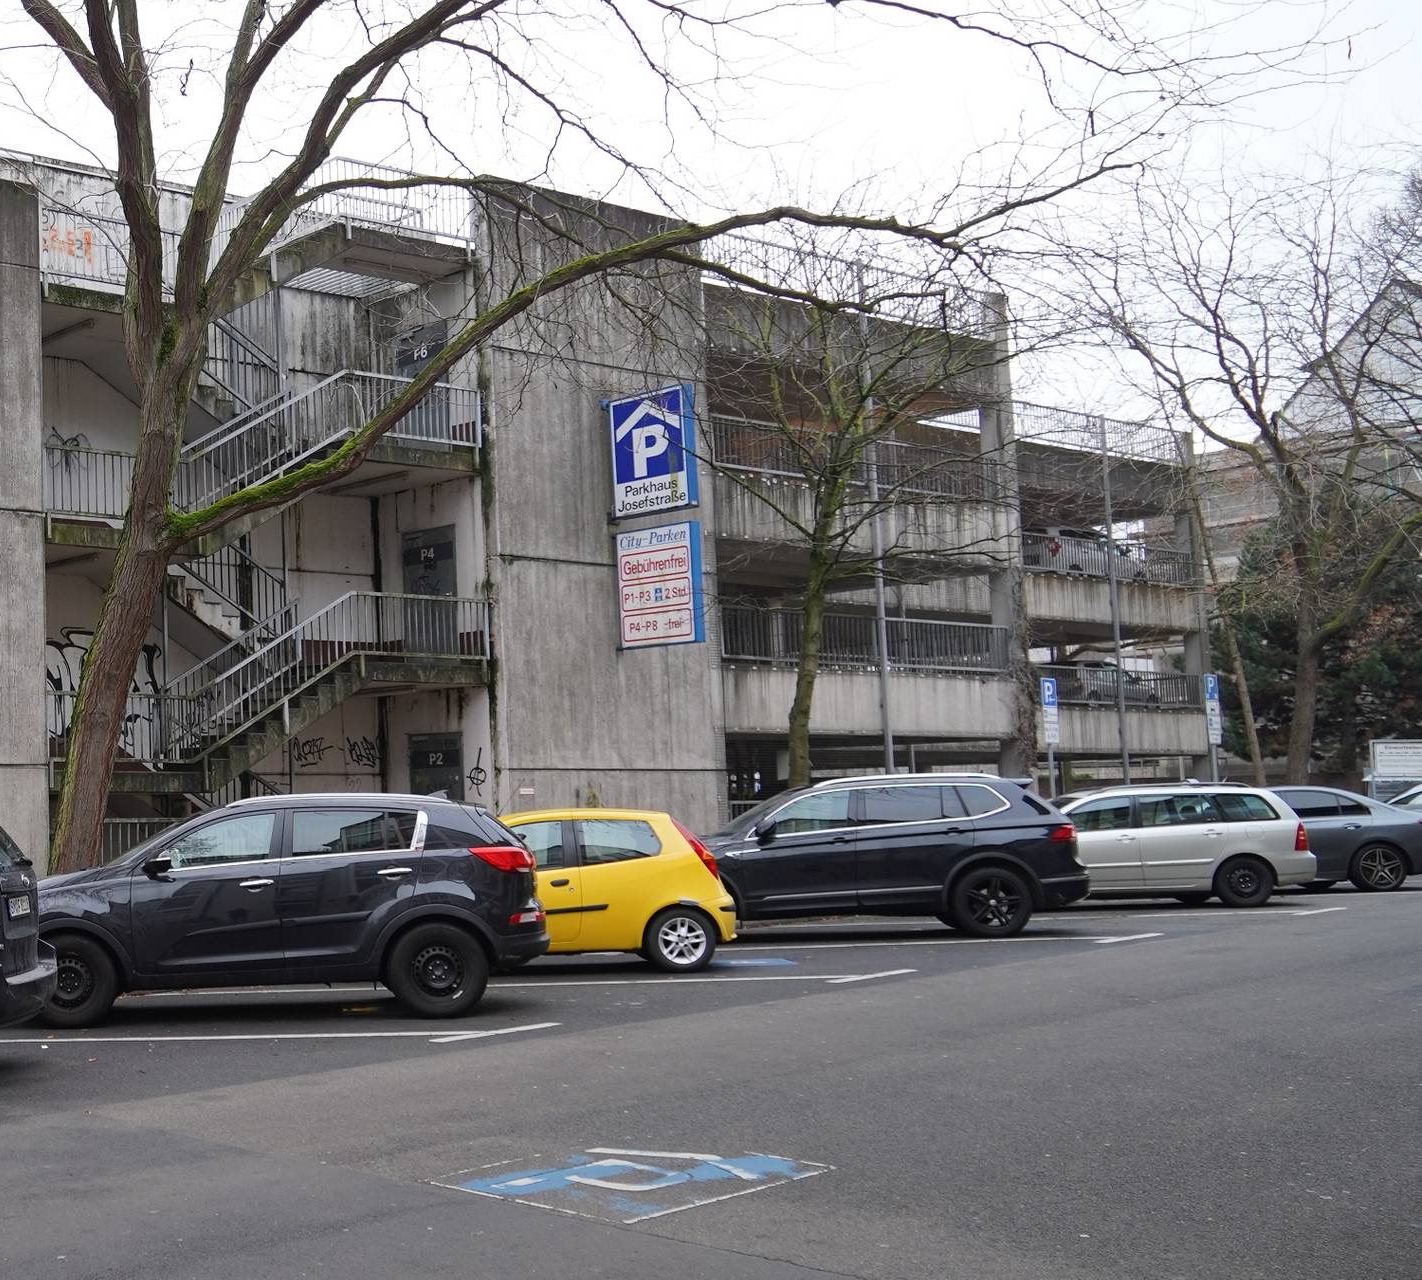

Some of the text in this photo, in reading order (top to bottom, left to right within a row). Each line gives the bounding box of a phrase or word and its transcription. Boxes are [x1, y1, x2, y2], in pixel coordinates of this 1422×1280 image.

[413, 342, 428, 361] P6
[631, 423, 669, 479] P
[624, 479, 678, 498] Parkhaus
[617, 489, 687, 513] Josefstraße
[420, 547, 435, 561] P4
[623, 552, 687, 576] Gebührenfrei
[624, 590, 652, 604] P1-P3
[665, 587, 671, 600] 2
[629, 619, 658, 633] P4-P8
[1043, 681, 1053, 704] P
[1206, 676, 1215, 693] P
[429, 752, 443, 765] P2
